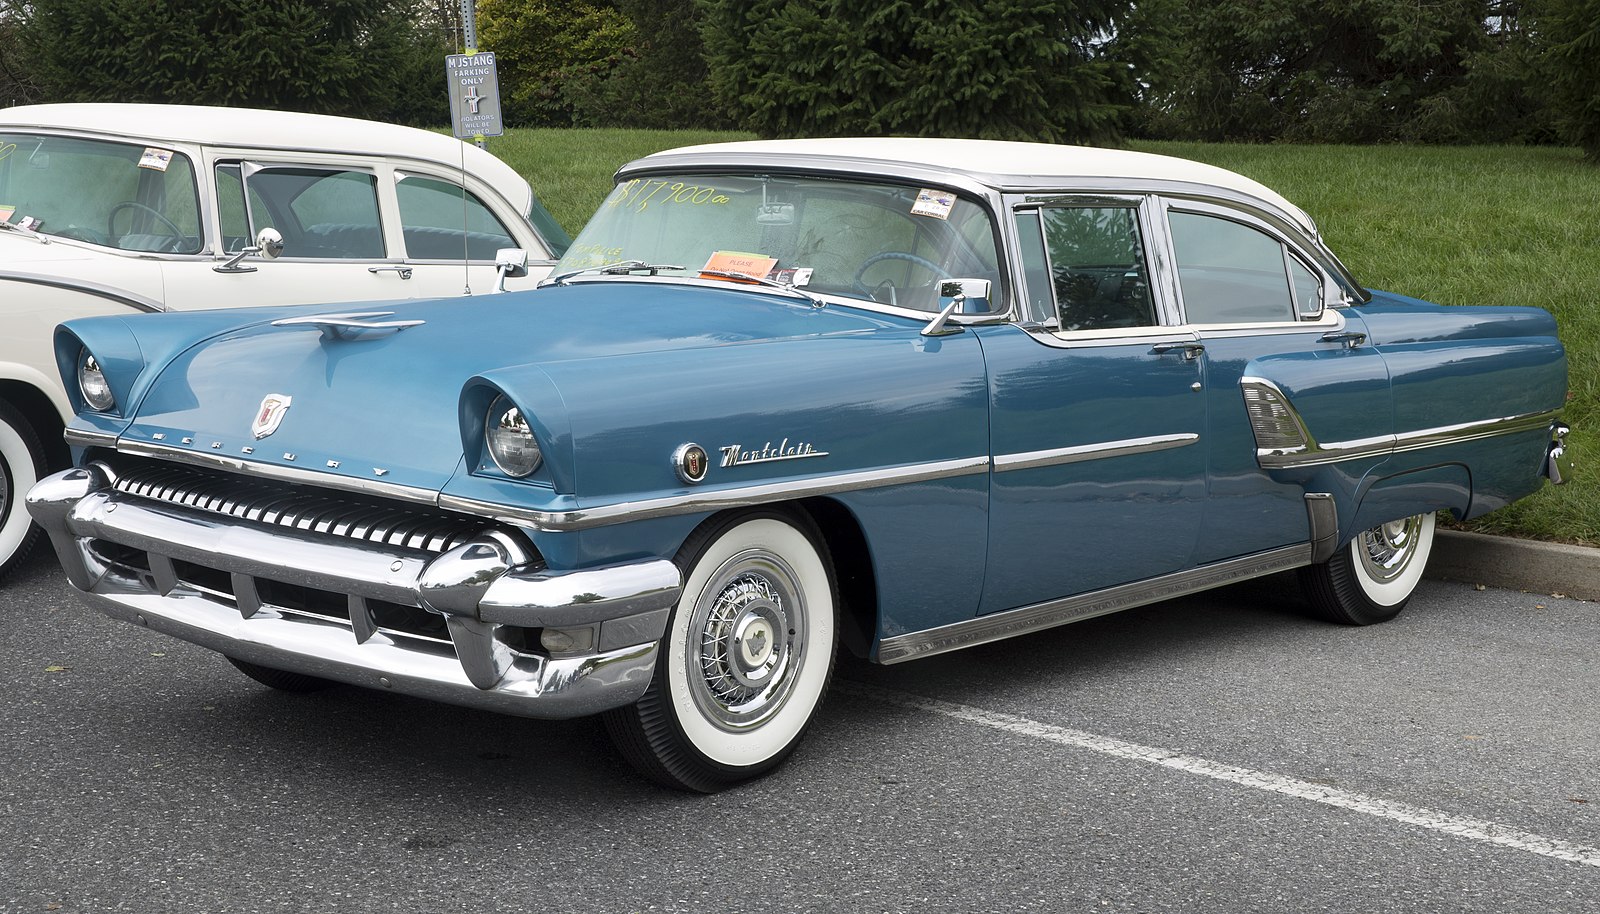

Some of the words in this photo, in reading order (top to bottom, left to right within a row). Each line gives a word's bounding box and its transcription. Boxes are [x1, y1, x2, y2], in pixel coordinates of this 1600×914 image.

[461, 77, 484, 85] ONLY
[729, 259, 754, 268] PLEASE
[152, 432, 389, 476] MERCURY
[719, 438, 829, 468] Montclair
